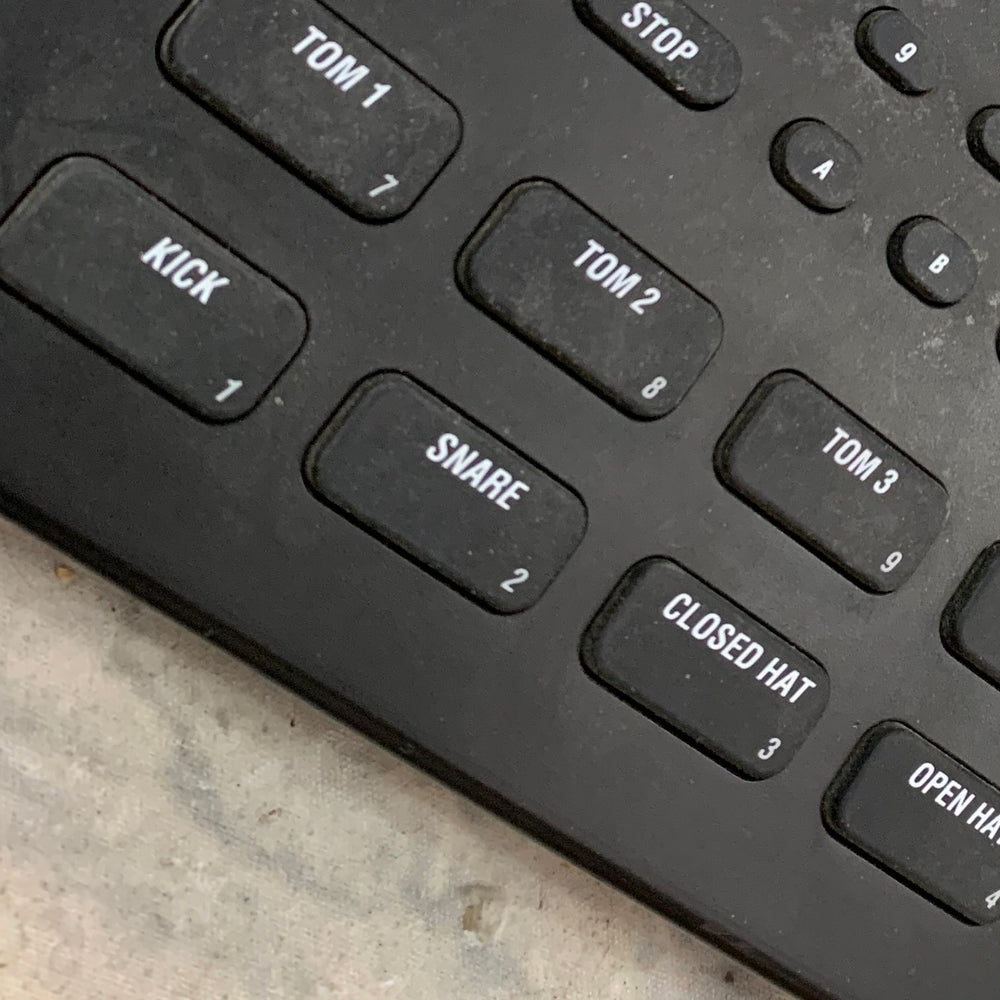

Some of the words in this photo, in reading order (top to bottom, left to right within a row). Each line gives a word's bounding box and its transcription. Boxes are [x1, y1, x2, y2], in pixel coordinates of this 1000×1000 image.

[621, 1, 699, 62] STOP
[894, 42, 918, 63] 9
[292, 25, 369, 92] TOM
[361, 82, 392, 108] 1
[811, 159, 834, 181] A
[368, 173, 399, 198] 7
[140, 236, 230, 305] KICK
[928, 253, 950, 274] B
[573, 239, 645, 299] TOM
[634, 286, 661, 315] 2
[215, 379, 243, 402] 1
[641, 376, 668, 399] 8
[425, 433, 530, 511] SNARE
[822, 427, 883, 483] TOM
[874, 469, 899, 495] 3
[880, 551, 903, 573] 9
[500, 567, 530, 593] 2
[662, 593, 763, 671] CLOSED
[756, 656, 817, 704] HAT
[757, 737, 782, 760] 3
[908, 762, 975, 819] OPEN
